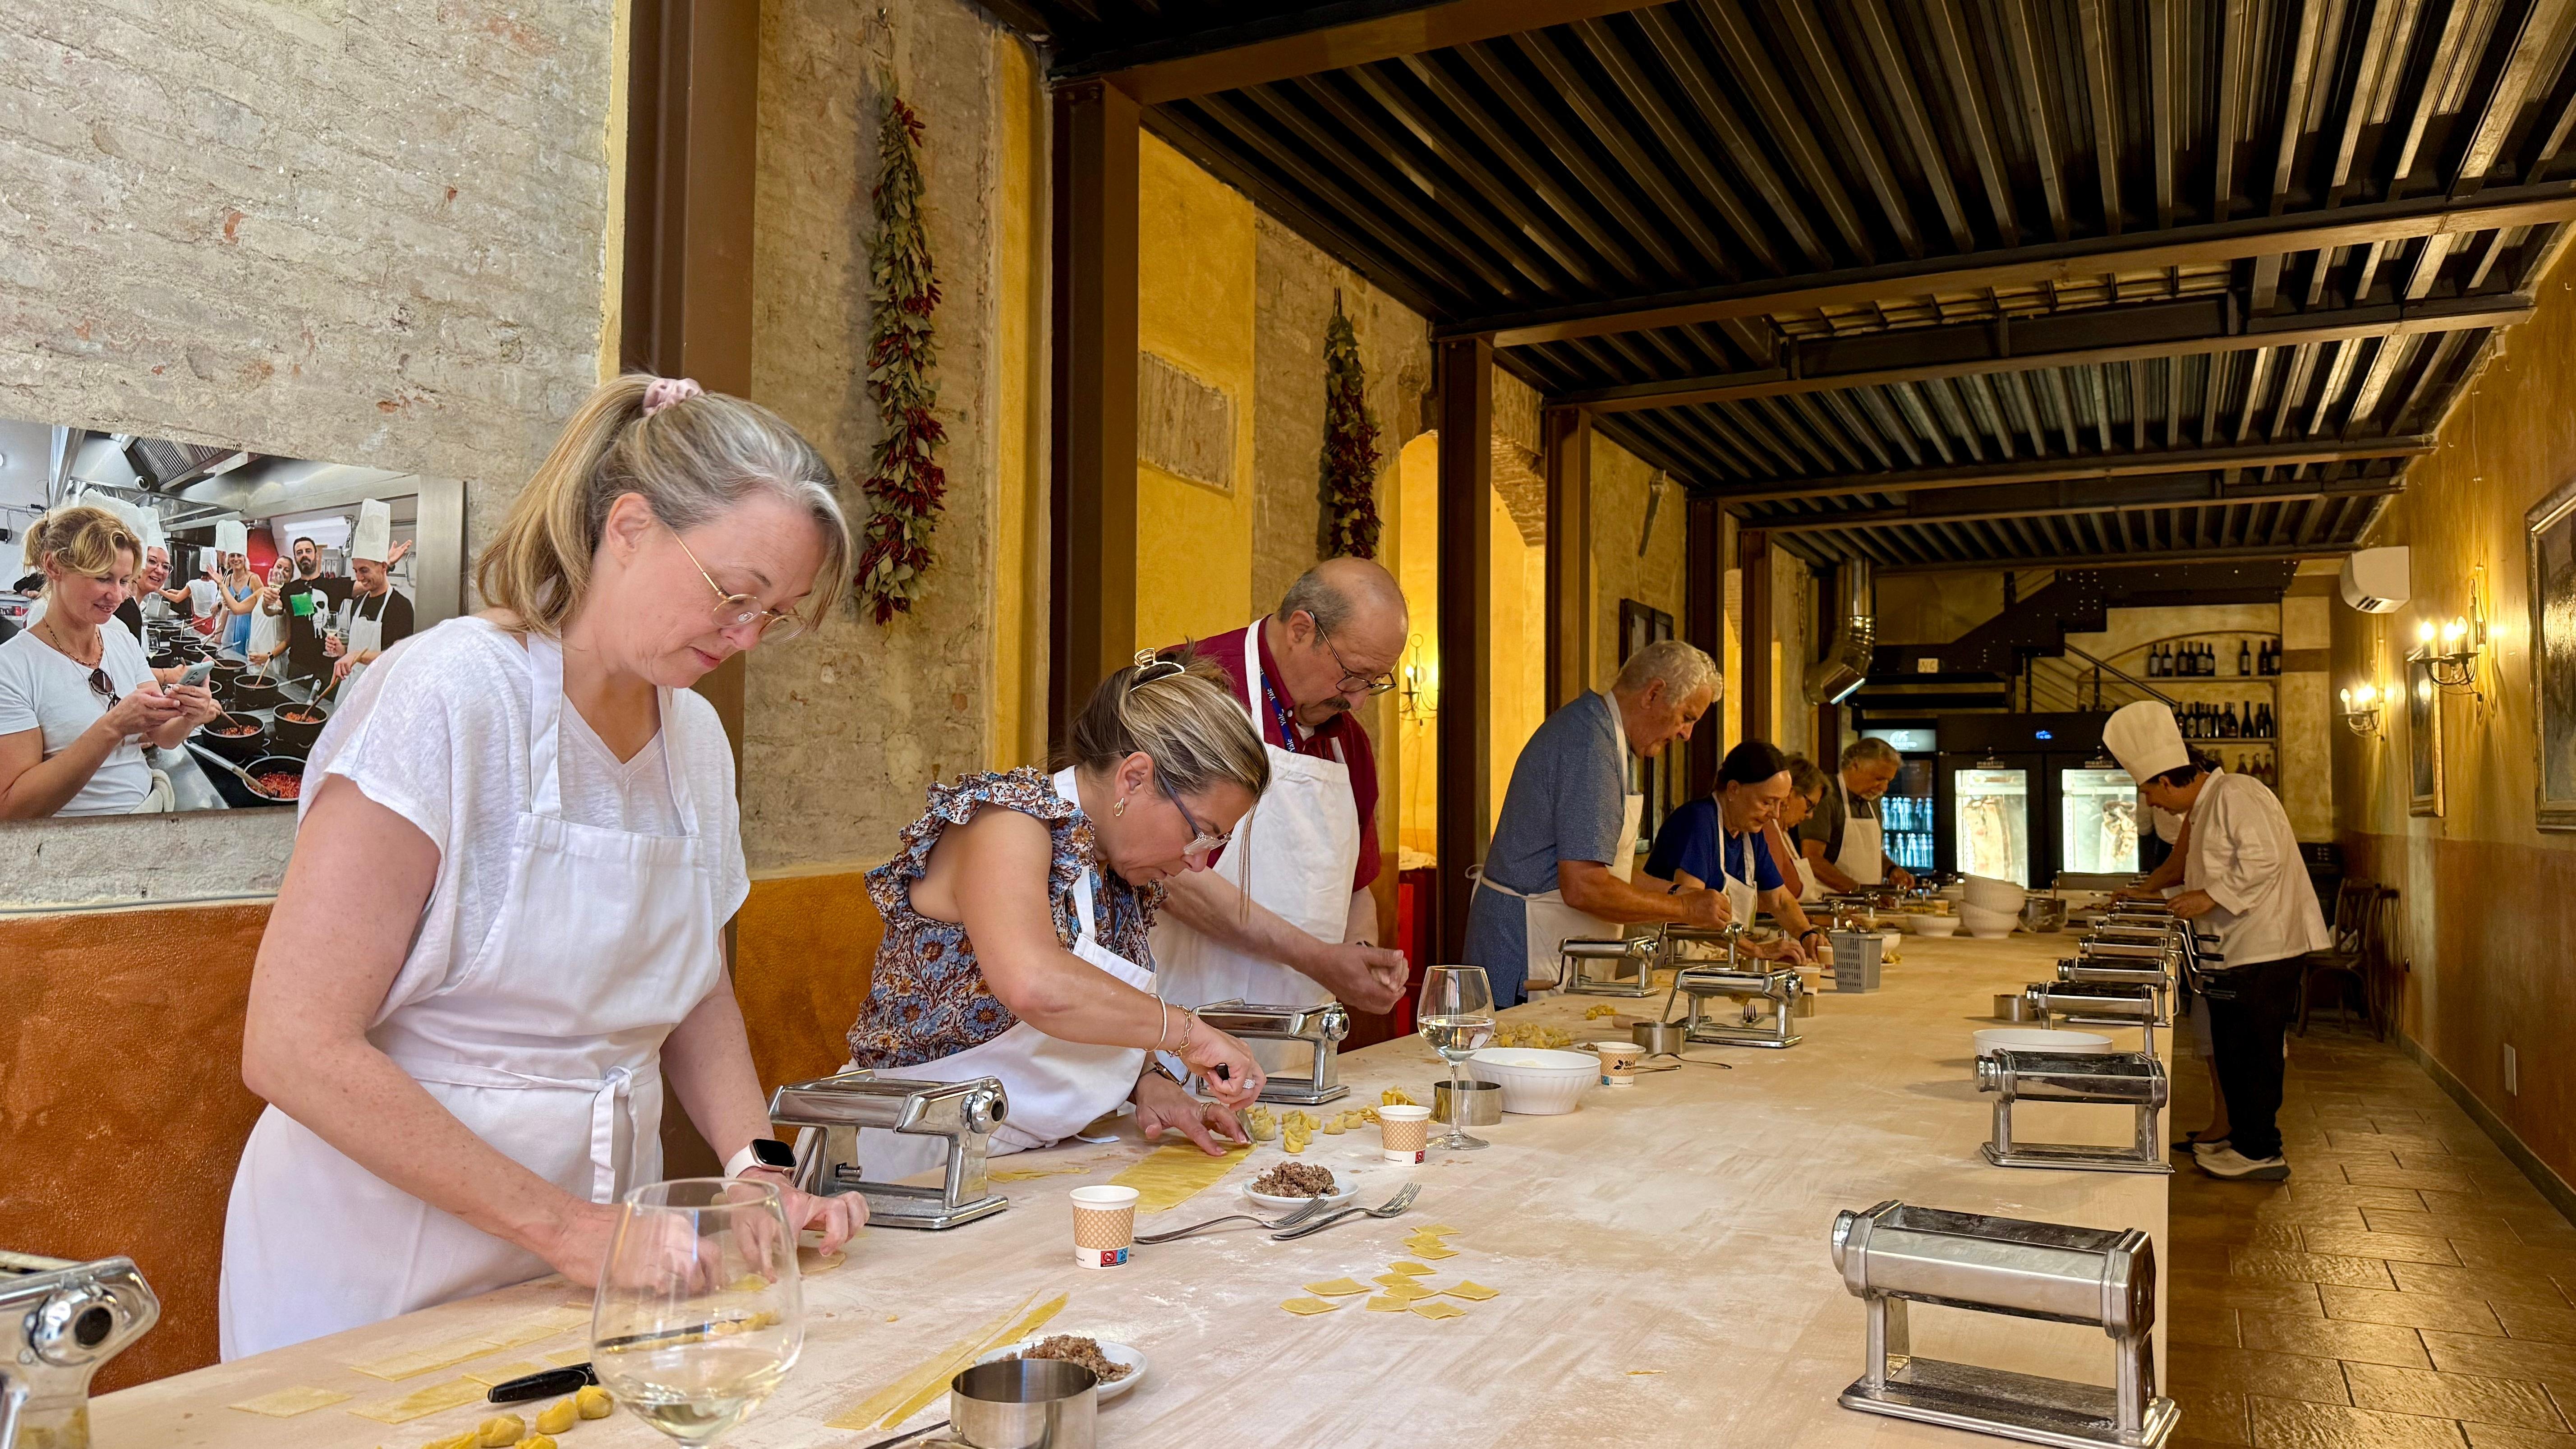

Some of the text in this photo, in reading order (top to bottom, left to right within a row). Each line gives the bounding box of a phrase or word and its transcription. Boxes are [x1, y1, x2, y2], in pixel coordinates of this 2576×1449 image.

[1267, 688, 1276, 701] Yale
[1278, 713, 1286, 726] Yale
[1287, 738, 1295, 752] Yale
